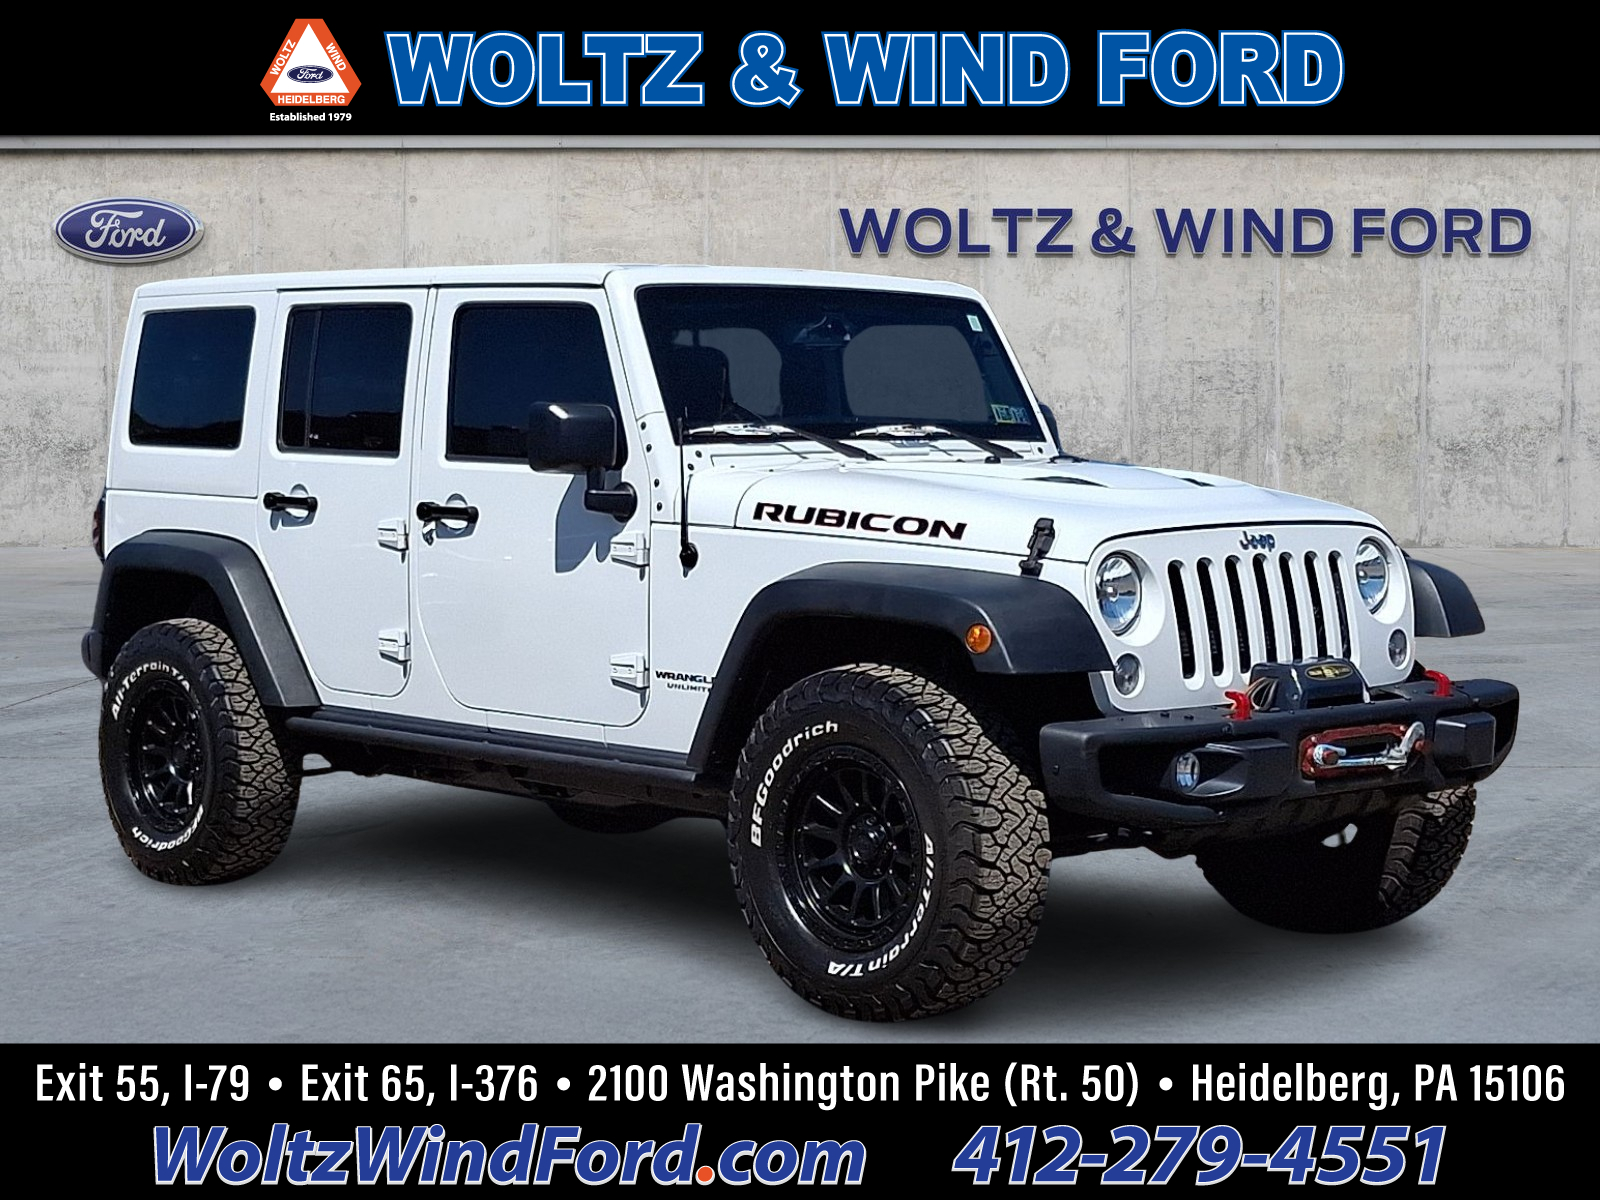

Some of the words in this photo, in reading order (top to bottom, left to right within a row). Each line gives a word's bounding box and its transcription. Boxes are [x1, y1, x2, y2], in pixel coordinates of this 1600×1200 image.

[85, 209, 166, 249] Ford
[840, 207, 1073, 255] WOLTZ
[1091, 207, 1136, 255] &
[1156, 207, 1333, 254] WIND
[1352, 207, 1532, 255] FORD
[753, 502, 967, 540] RUBICON
[1239, 530, 1276, 552] Jeep
[655, 670, 715, 684] WRANGL
[666, 682, 711, 692] UNLIMIT
[750, 720, 839, 848] BFGoodrich
